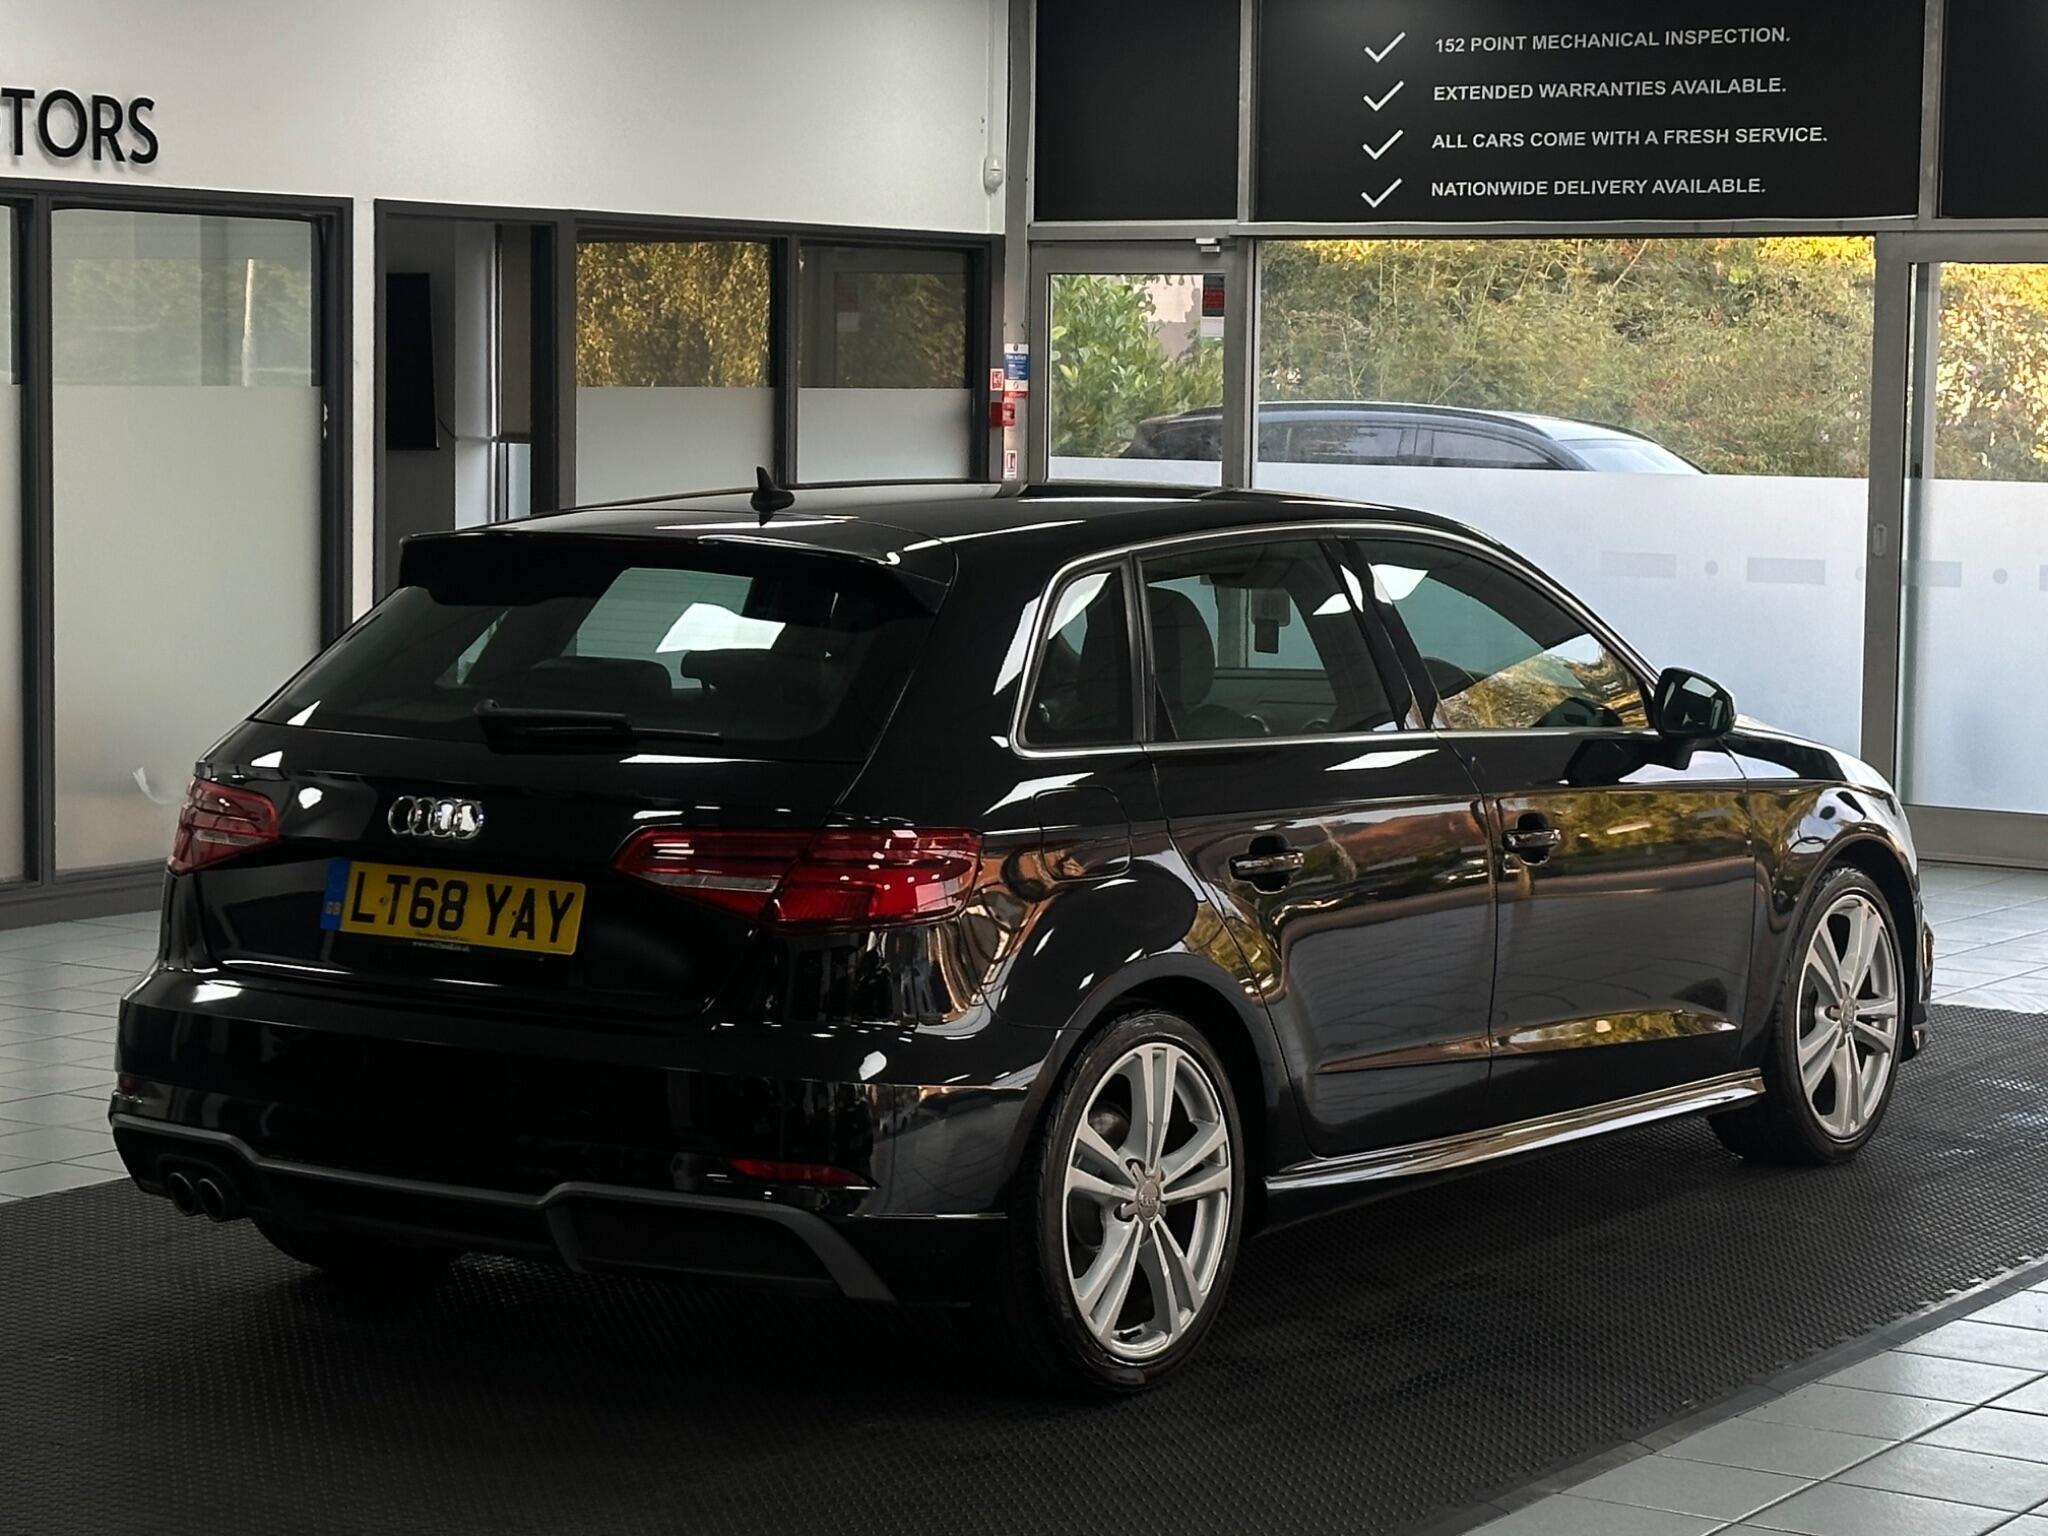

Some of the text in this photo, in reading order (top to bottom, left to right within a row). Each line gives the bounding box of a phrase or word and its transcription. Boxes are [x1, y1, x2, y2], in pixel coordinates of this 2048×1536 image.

[1435, 27, 1791, 53] 152 POINT MECHANICAL INSPECTION.
[1433, 77, 1787, 101] EXTENDED WARRANTIES AVAILABLE.
[1, 87, 159, 164] TORS
[1431, 126, 1828, 149] ALL CARS COME WITH A FRESH SERVICE.
[1431, 177, 1766, 197] NATIONWIDE DELIVERY AVAILABLE.
[350, 871, 576, 944] LT68 YAY
